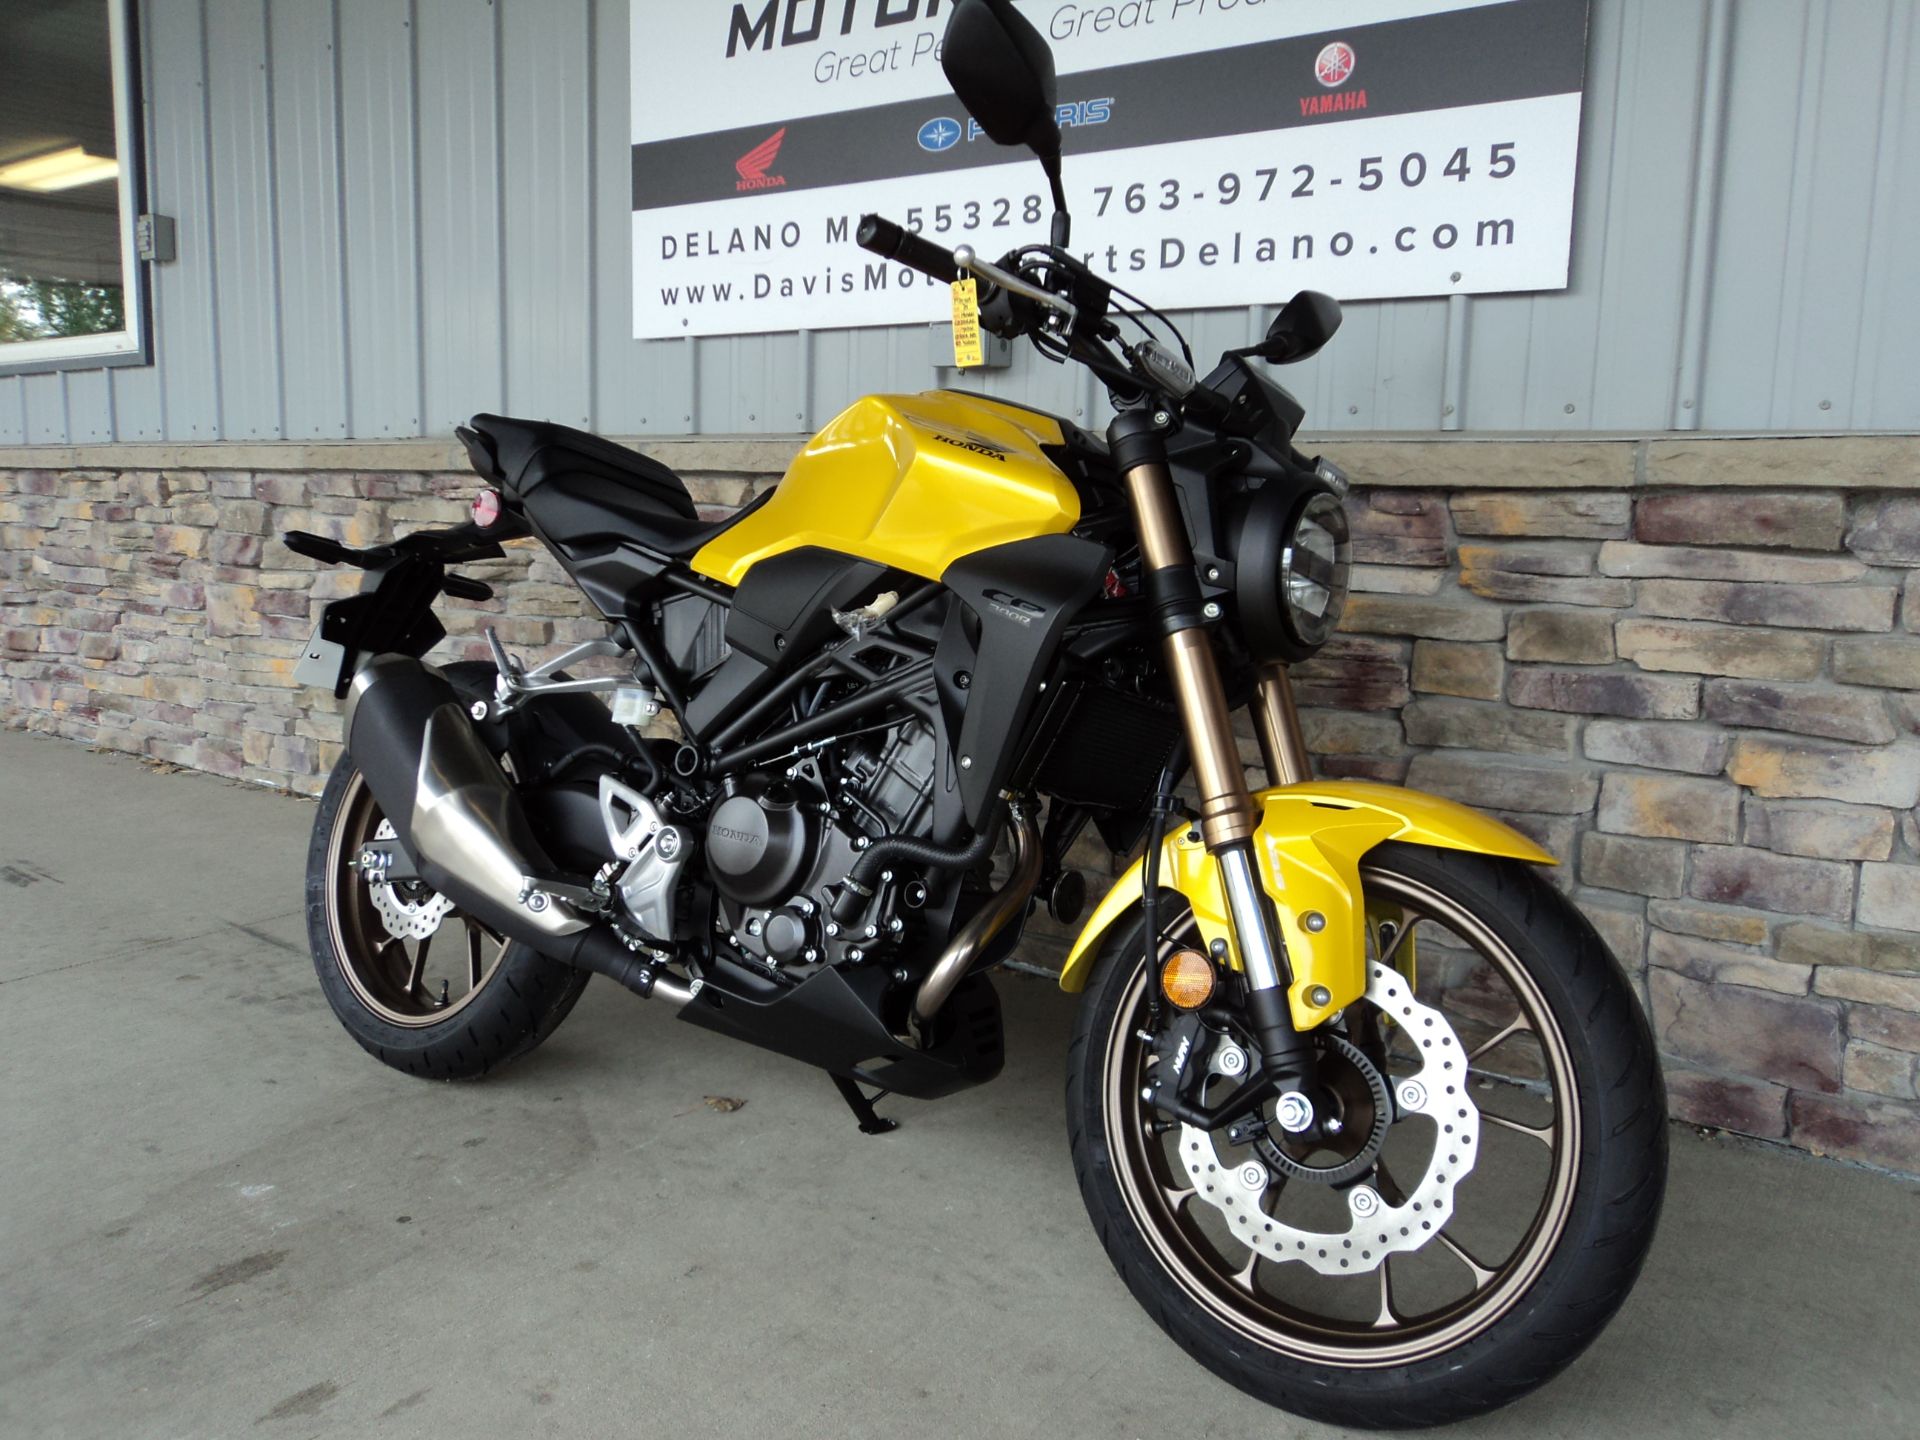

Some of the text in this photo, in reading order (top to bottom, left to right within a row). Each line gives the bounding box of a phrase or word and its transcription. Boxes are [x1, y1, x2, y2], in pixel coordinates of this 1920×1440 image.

[814, 40, 902, 84] Great
[1049, 0, 1155, 41] Great
[1300, 88, 1368, 117] YAMAHA
[967, 97, 1113, 142] PRIS
[735, 175, 786, 192] HONDA
[661, 221, 801, 261] DELANO
[906, 194, 1042, 235] 55328
[1093, 141, 1517, 218] 763-972-5045
[932, 433, 1007, 463] HONDA
[711, 824, 761, 847] HONDA
